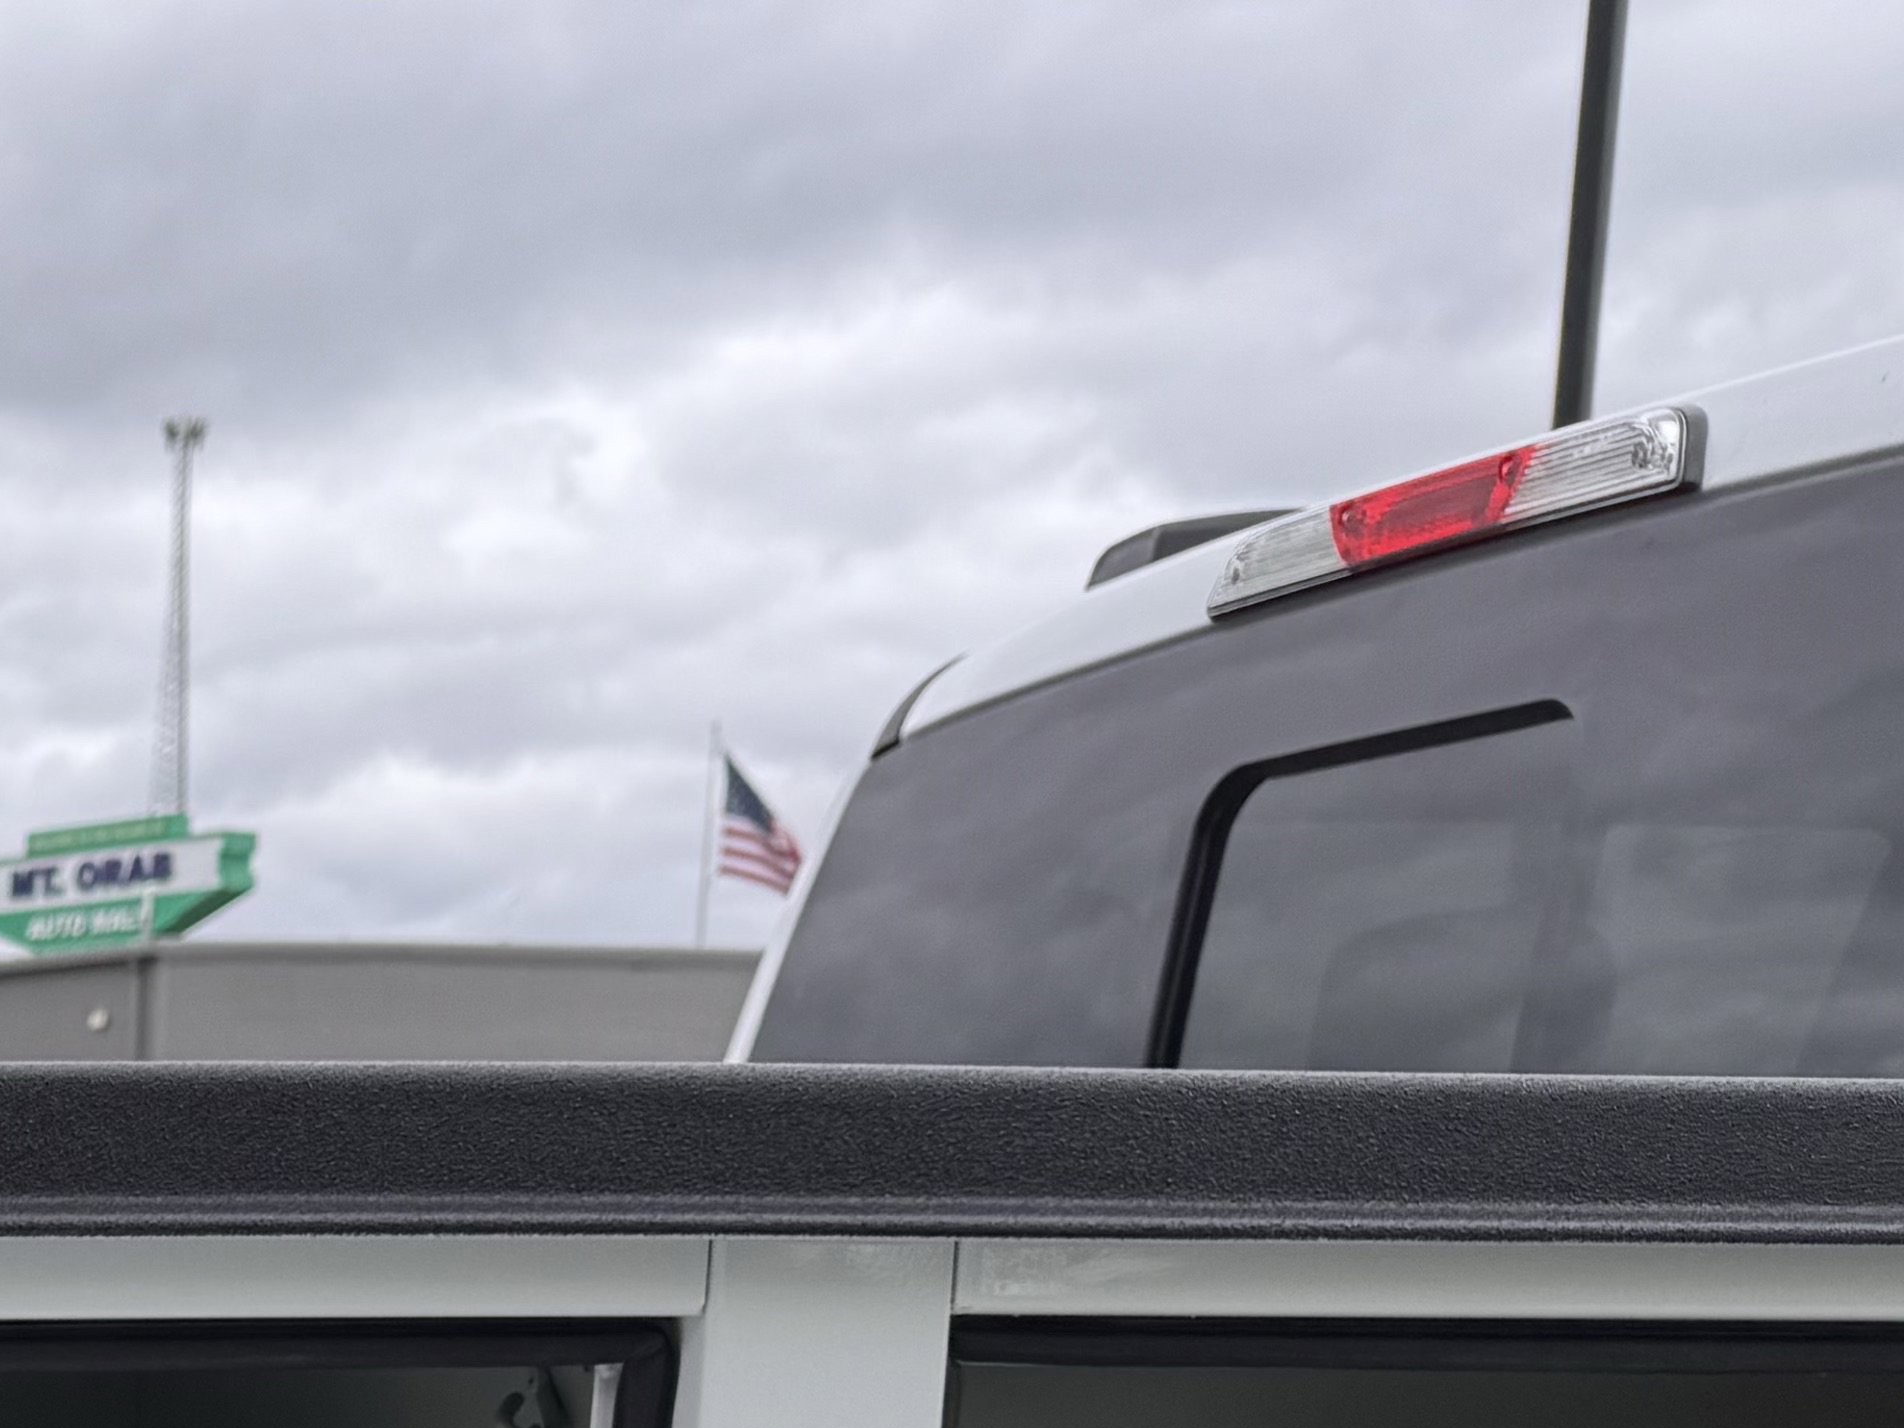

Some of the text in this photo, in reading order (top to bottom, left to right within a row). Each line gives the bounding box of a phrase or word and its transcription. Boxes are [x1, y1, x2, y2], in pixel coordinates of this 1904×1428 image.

[11, 852, 173, 898] MT. ORAB
[25, 912, 87, 941] AUTO
